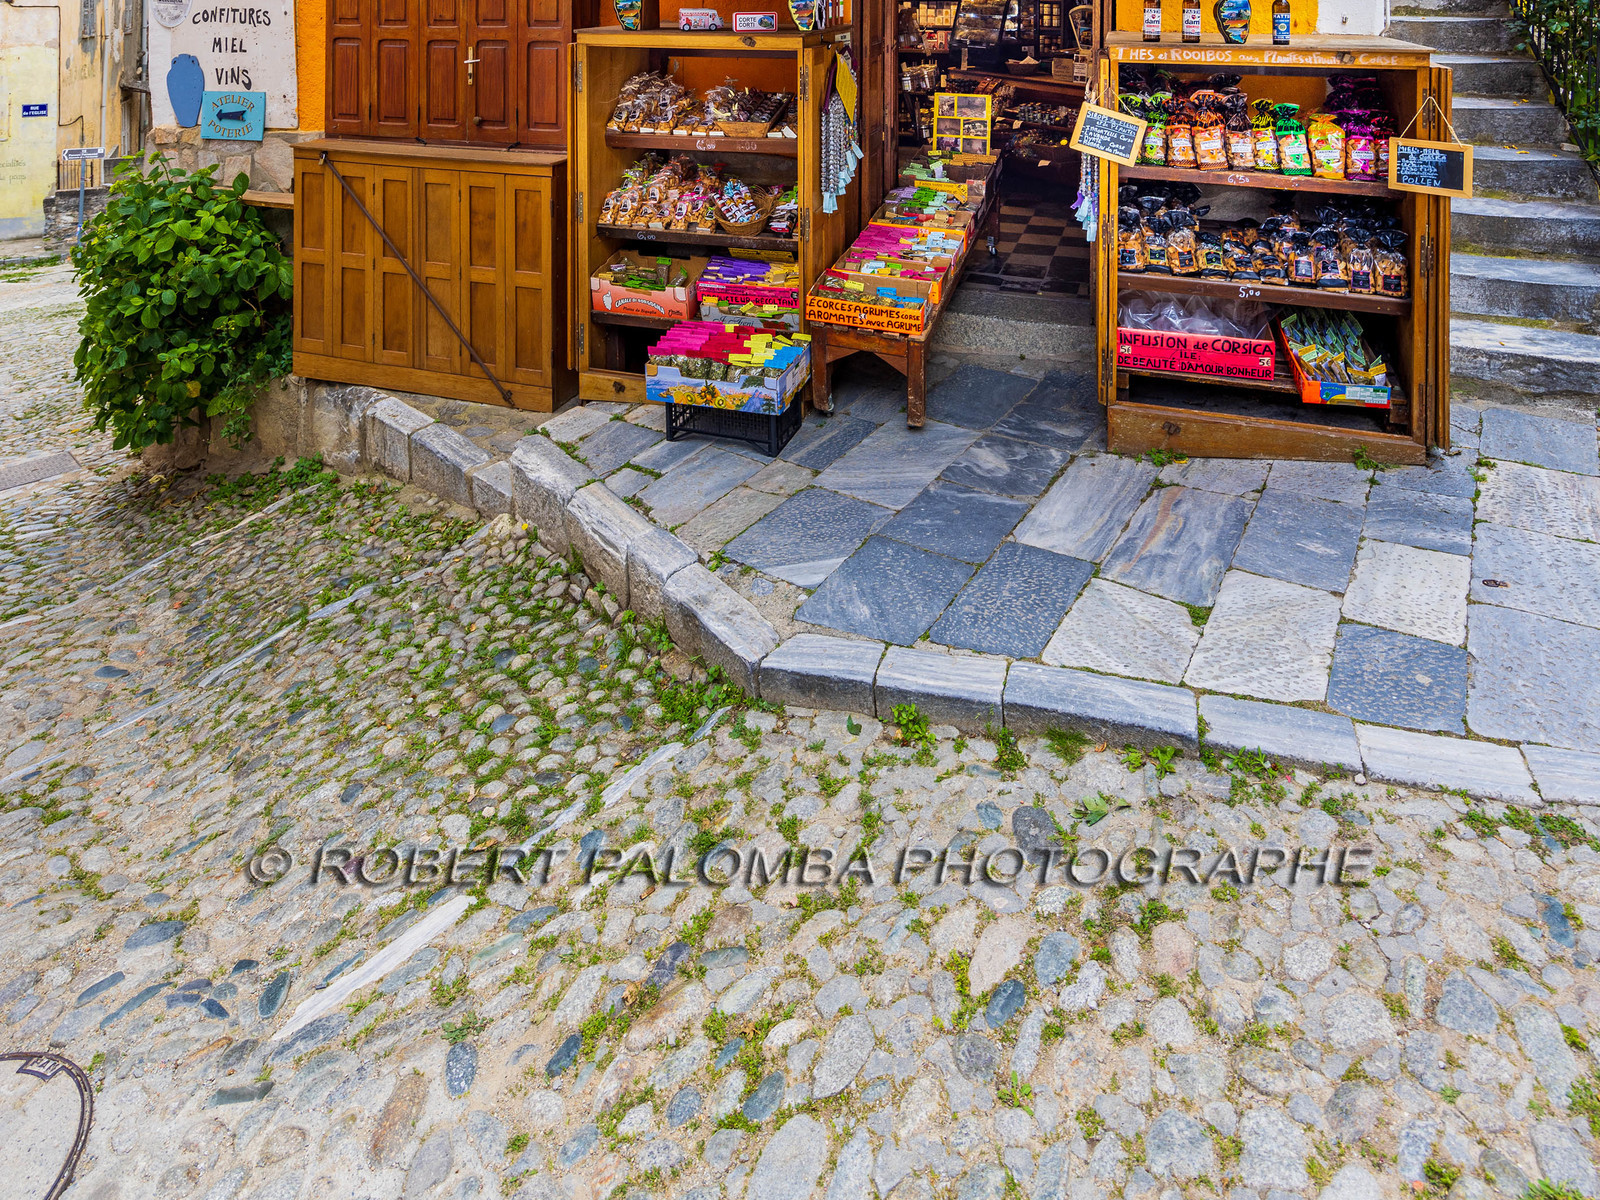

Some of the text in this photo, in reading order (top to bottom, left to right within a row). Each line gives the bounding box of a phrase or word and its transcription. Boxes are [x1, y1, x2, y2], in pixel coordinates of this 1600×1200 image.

[192, 6, 271, 27] CONFITURES
[212, 37, 247, 53] MIEL
[1170, 48, 1233, 62] ROOIBOS
[215, 66, 252, 90] VINS
[211, 94, 255, 112] ATELIER
[208, 119, 253, 138] POTERIE
[1402, 175, 1441, 187] POLLEN
[808, 309, 864, 325] AROMATES
[854, 305, 900, 318] AGRUMES
[901, 313, 920, 321] CORSE
[1120, 345, 1132, 354] 5€
[1193, 341, 1209, 351] de
[1117, 355, 1132, 365] DE
[1259, 358, 1271, 366] 5€
